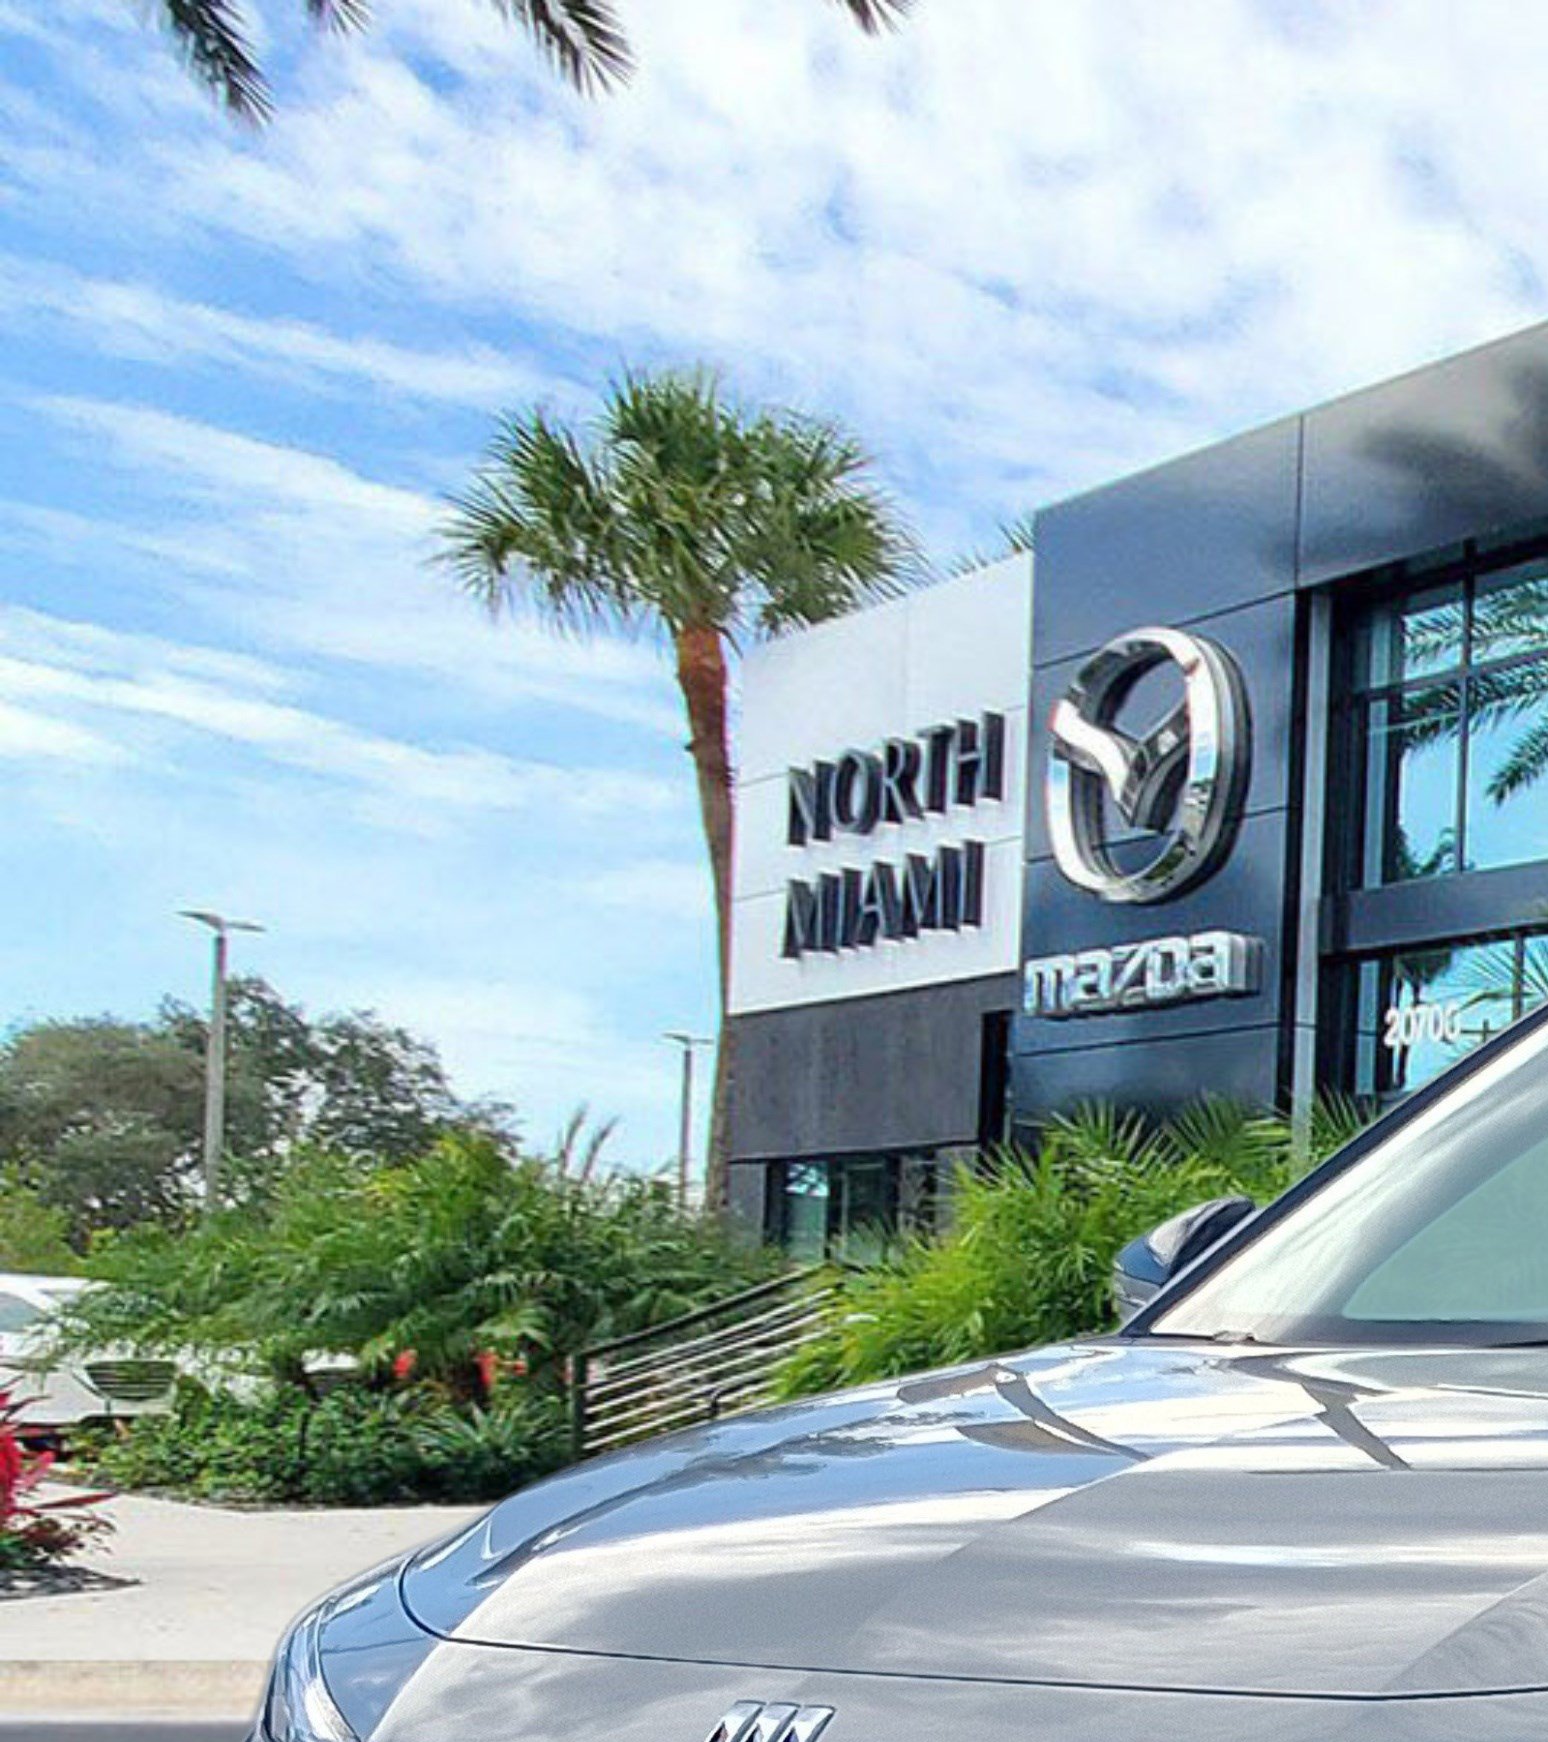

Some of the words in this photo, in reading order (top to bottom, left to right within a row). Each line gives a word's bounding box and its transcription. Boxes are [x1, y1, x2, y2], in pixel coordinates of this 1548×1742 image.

[786, 709, 1005, 847] NORTH
[780, 839, 985, 959] MIAMI
[1023, 930, 1264, 1020] mazda
